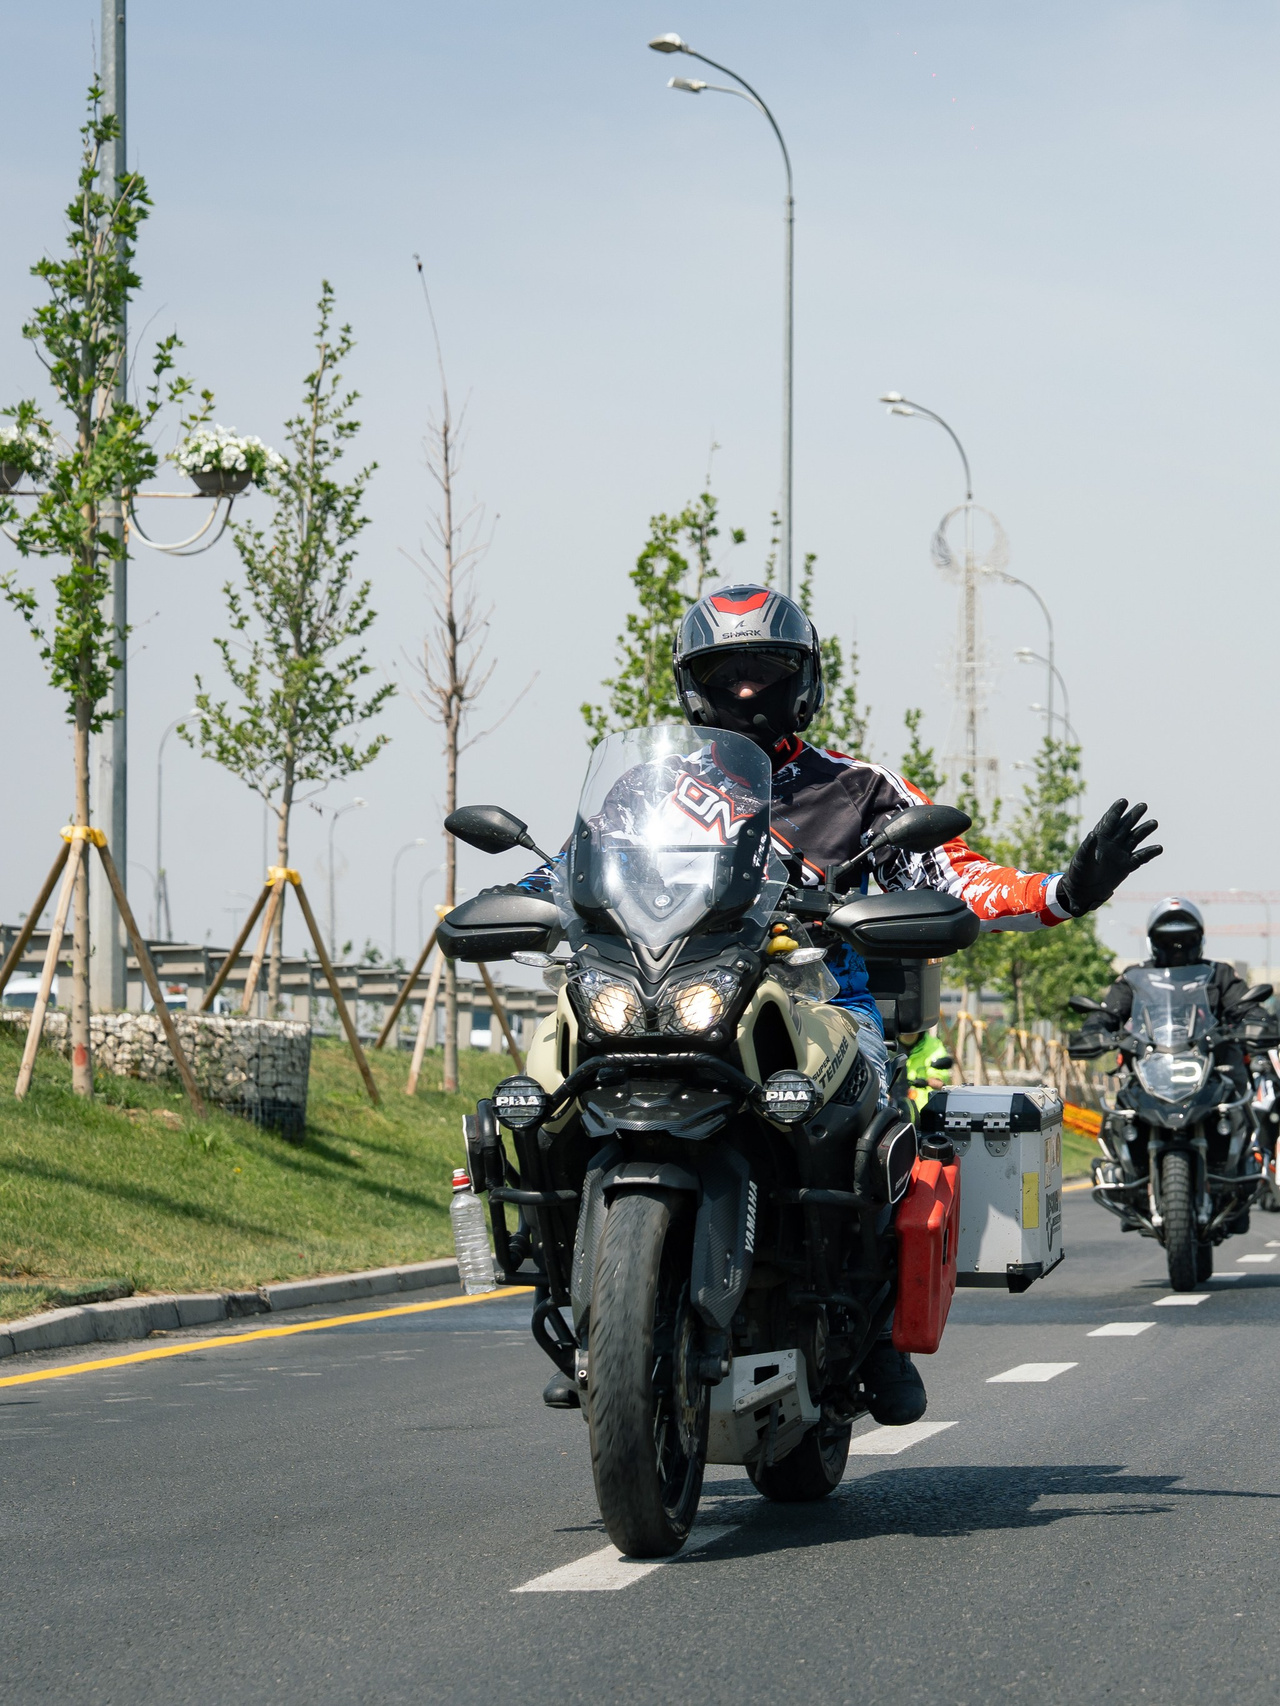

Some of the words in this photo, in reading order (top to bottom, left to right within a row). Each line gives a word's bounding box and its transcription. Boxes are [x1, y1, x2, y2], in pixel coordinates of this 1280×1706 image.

[722, 630, 761, 640] SHARK
[812, 1056, 831, 1081] SUPER
[495, 1095, 540, 1107] PIAA
[765, 1090, 809, 1101] PIAA
[744, 1180, 758, 1254] YAMAHA
